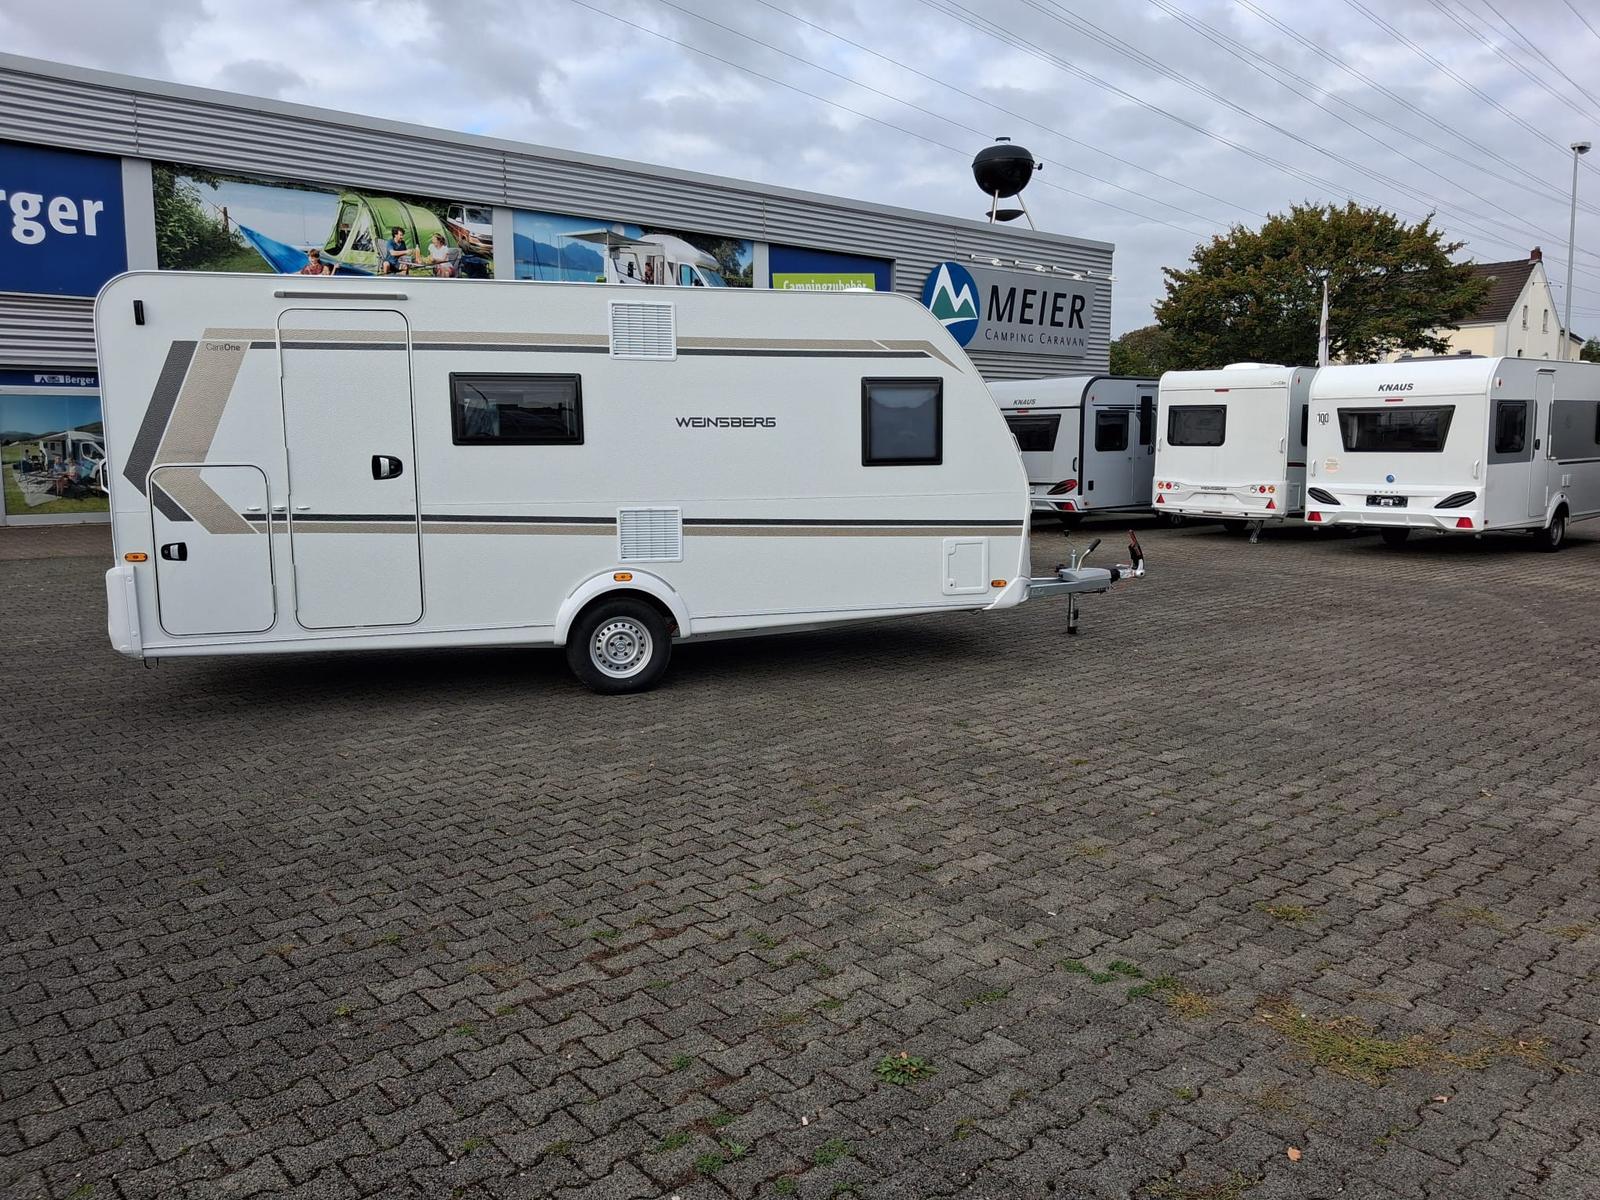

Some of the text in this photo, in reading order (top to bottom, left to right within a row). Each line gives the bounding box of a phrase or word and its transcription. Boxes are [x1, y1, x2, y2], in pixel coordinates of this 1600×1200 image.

[987, 285, 1085, 329] MEIER
[985, 328, 1084, 347] CAMPING CARAVAN
[65, 375, 95, 386] Berger
[1378, 382, 1414, 392] KNAUS
[675, 417, 776, 427] WEINSBERG
